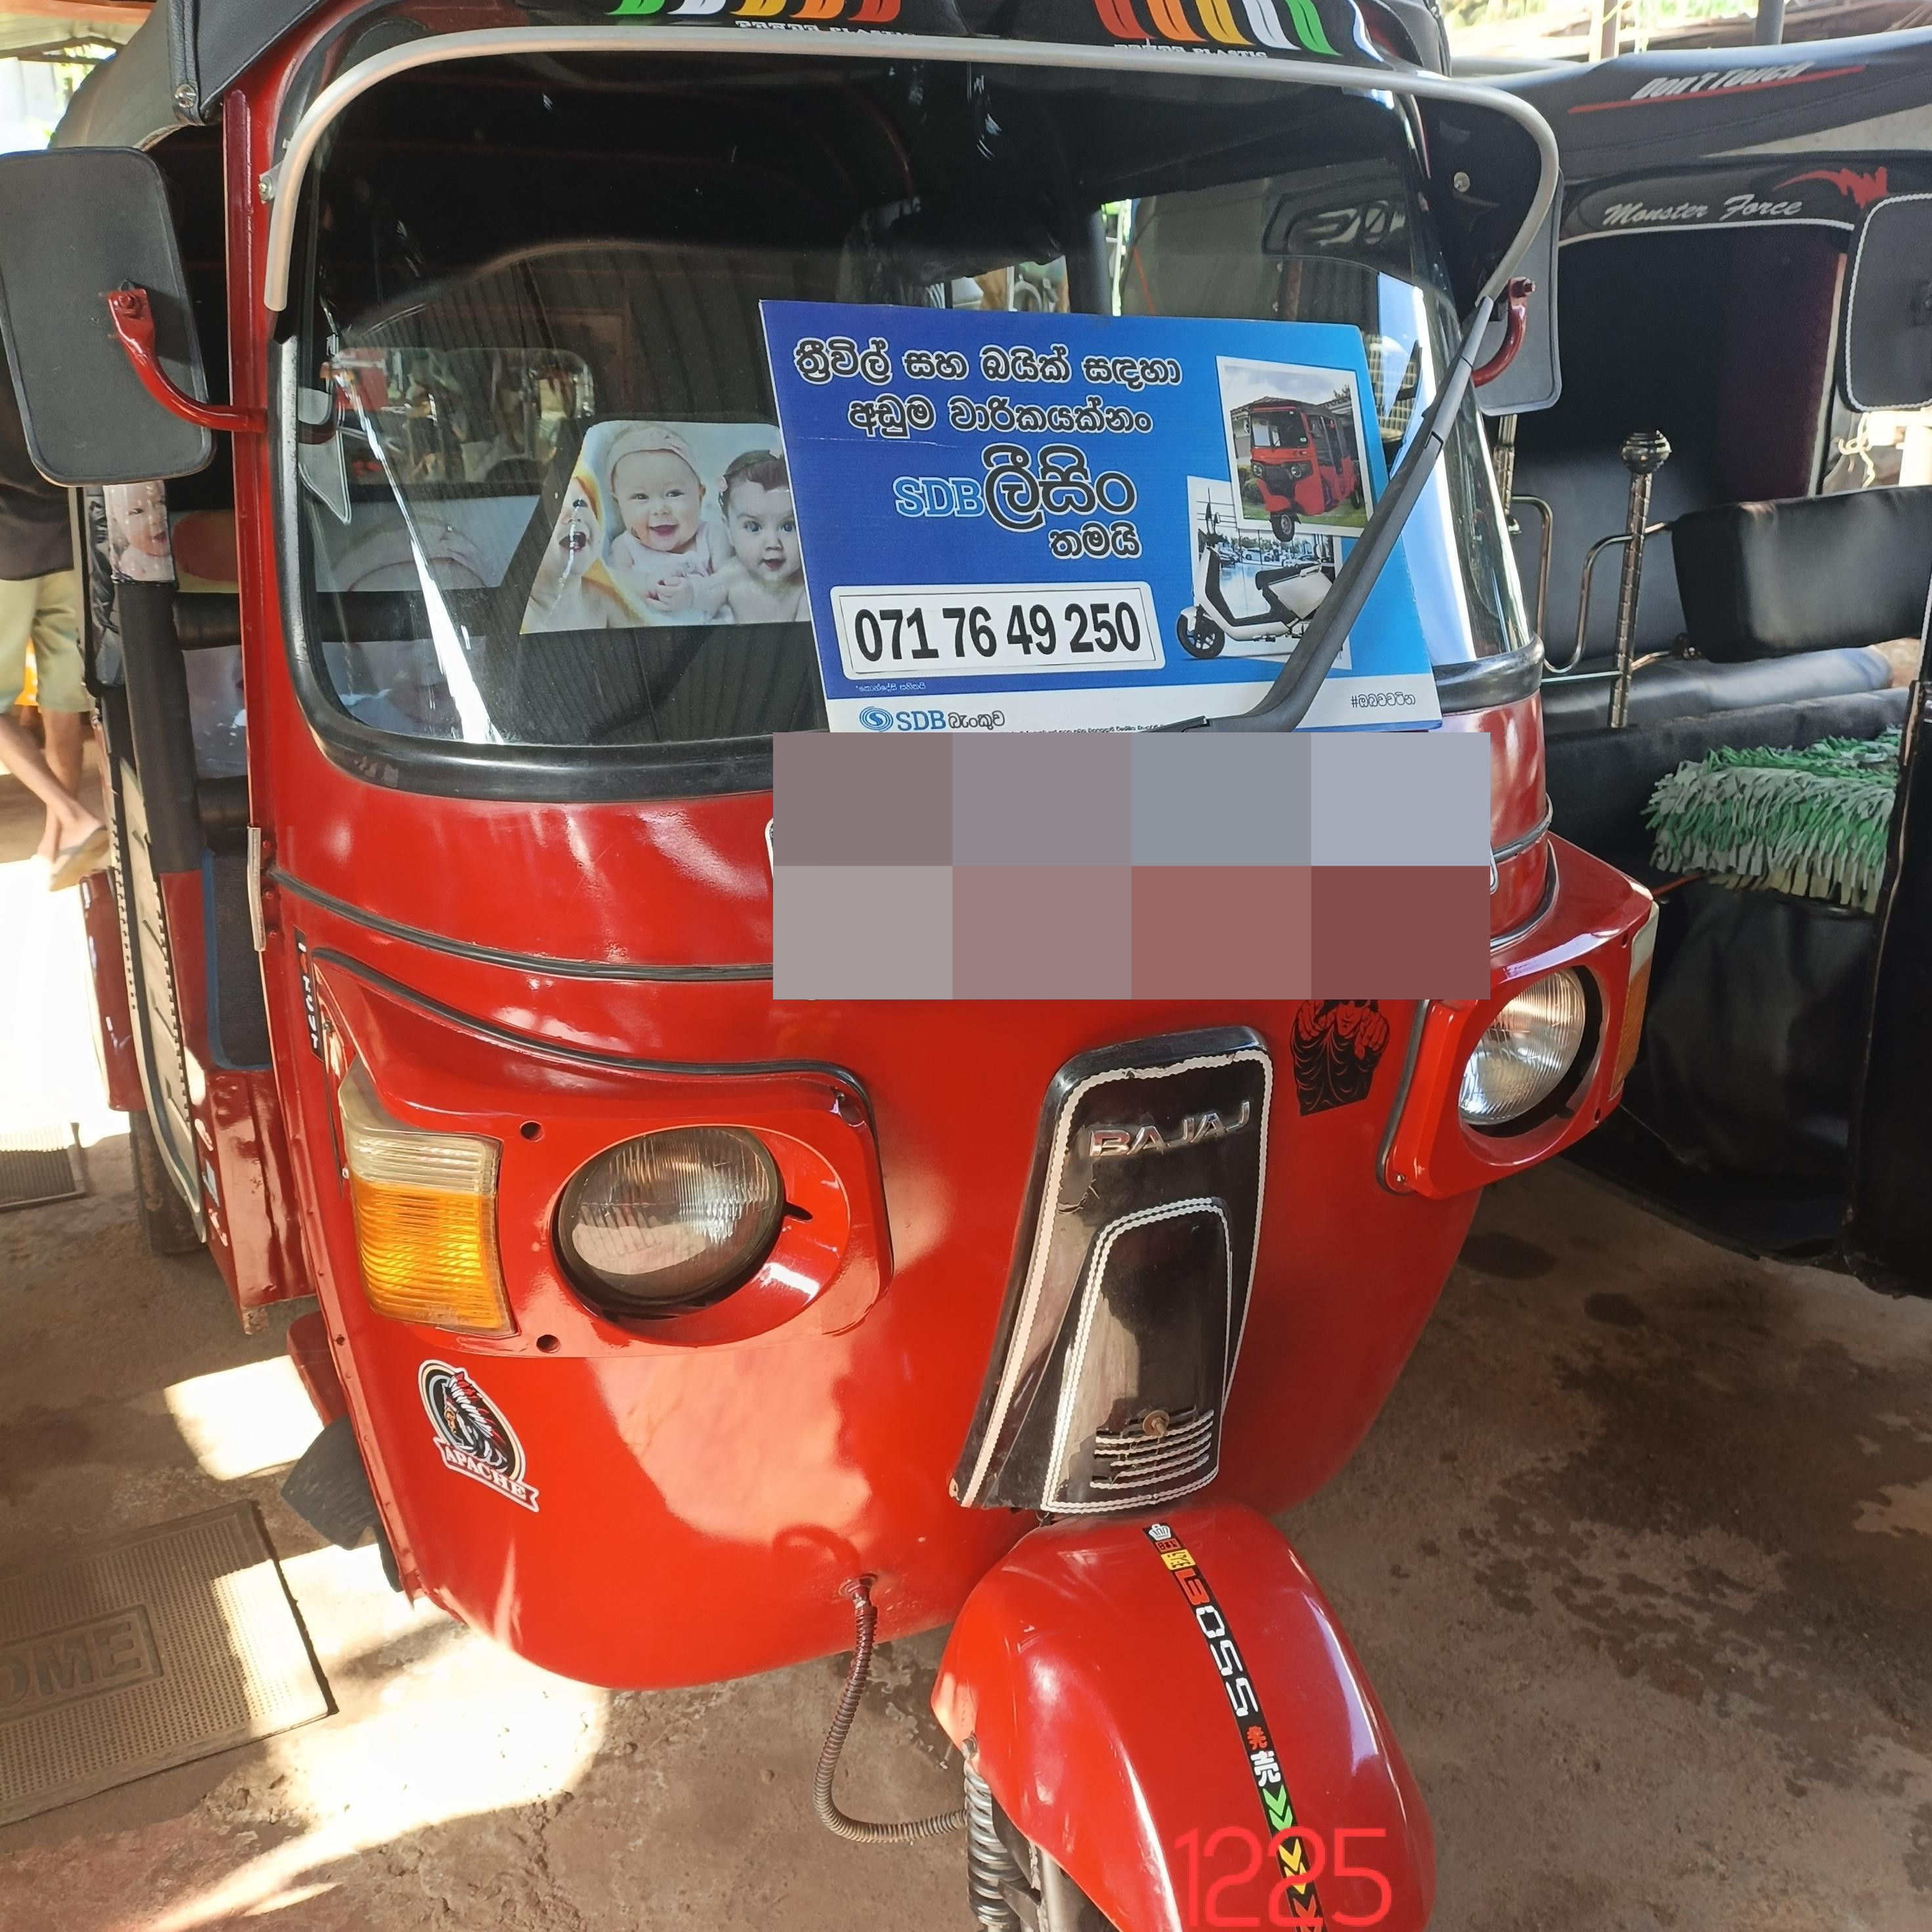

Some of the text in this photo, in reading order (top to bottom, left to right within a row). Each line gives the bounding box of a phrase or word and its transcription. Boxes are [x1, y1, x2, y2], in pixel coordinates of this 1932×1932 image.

[1602, 194, 1803, 226] Monster Force
[902, 350, 969, 380] සහ
[1082, 355, 1183, 392] සඳහා
[848, 393, 1154, 439] අඩුම වාරිකයක්නං
[1048, 520, 1143, 558] තමයි
[854, 601, 1141, 662] 071 76 49 250
[896, 710, 946, 731] SDB
[1089, 1101, 1250, 1157] BAJAJ
[444, 1446, 527, 1501] APACHE
